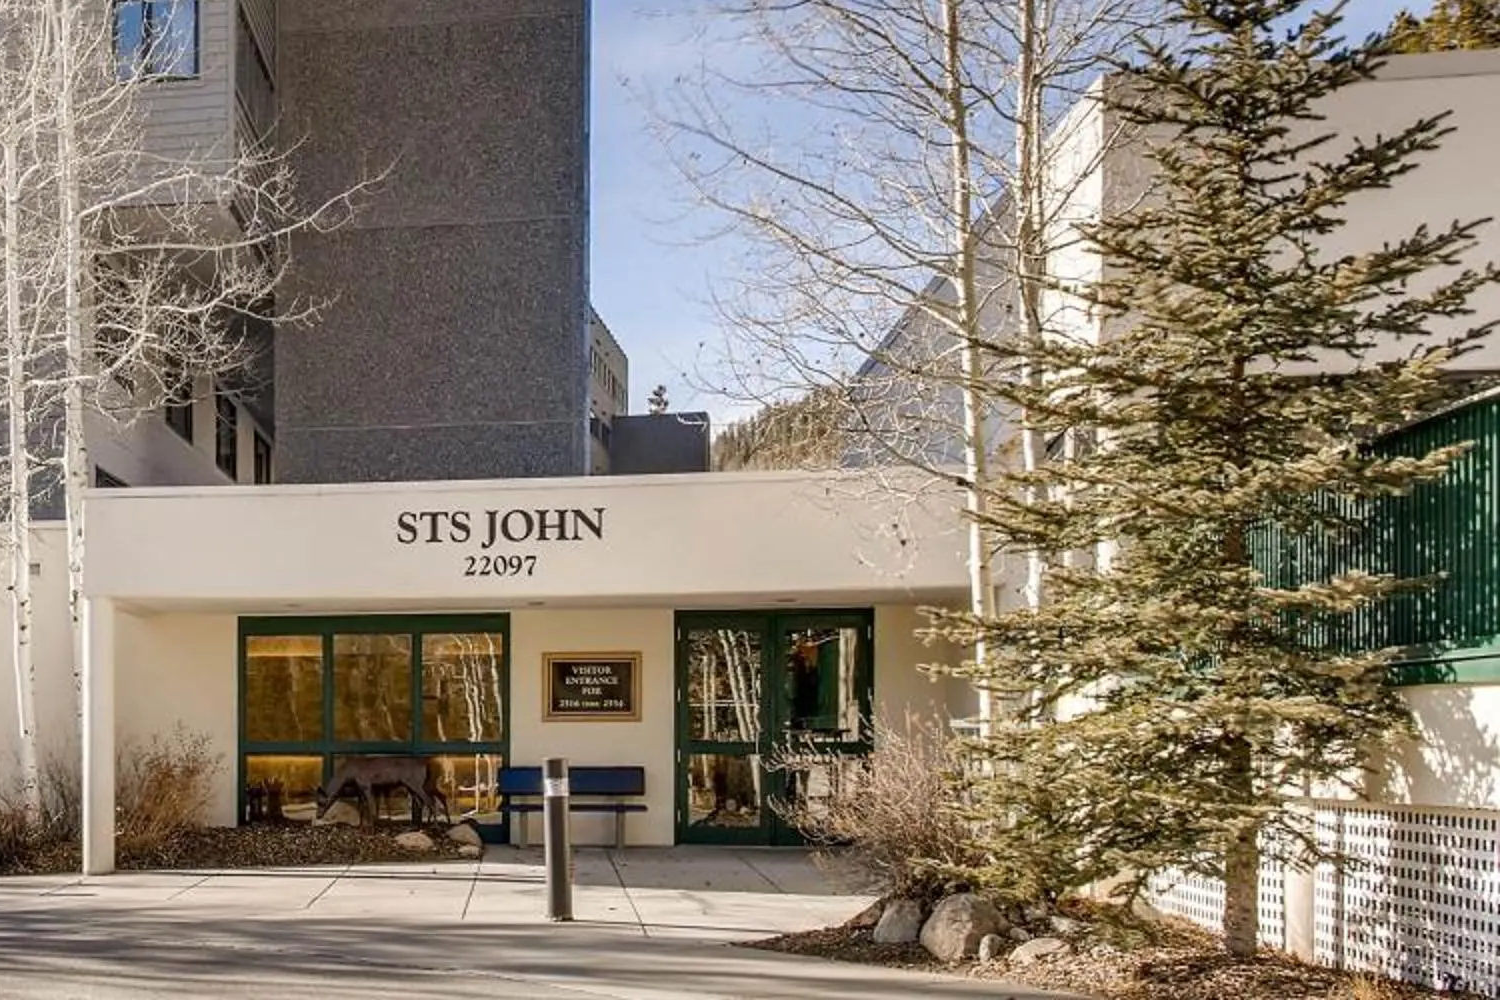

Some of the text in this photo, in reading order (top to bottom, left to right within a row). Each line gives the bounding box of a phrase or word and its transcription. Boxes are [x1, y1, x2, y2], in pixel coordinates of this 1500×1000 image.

[397, 507, 606, 549] STS JOHN
[464, 555, 537, 576] 22097
[572, 665, 612, 675] VISITOR
[565, 676, 619, 685] ENTRANCE
[582, 687, 602, 695] FOR
